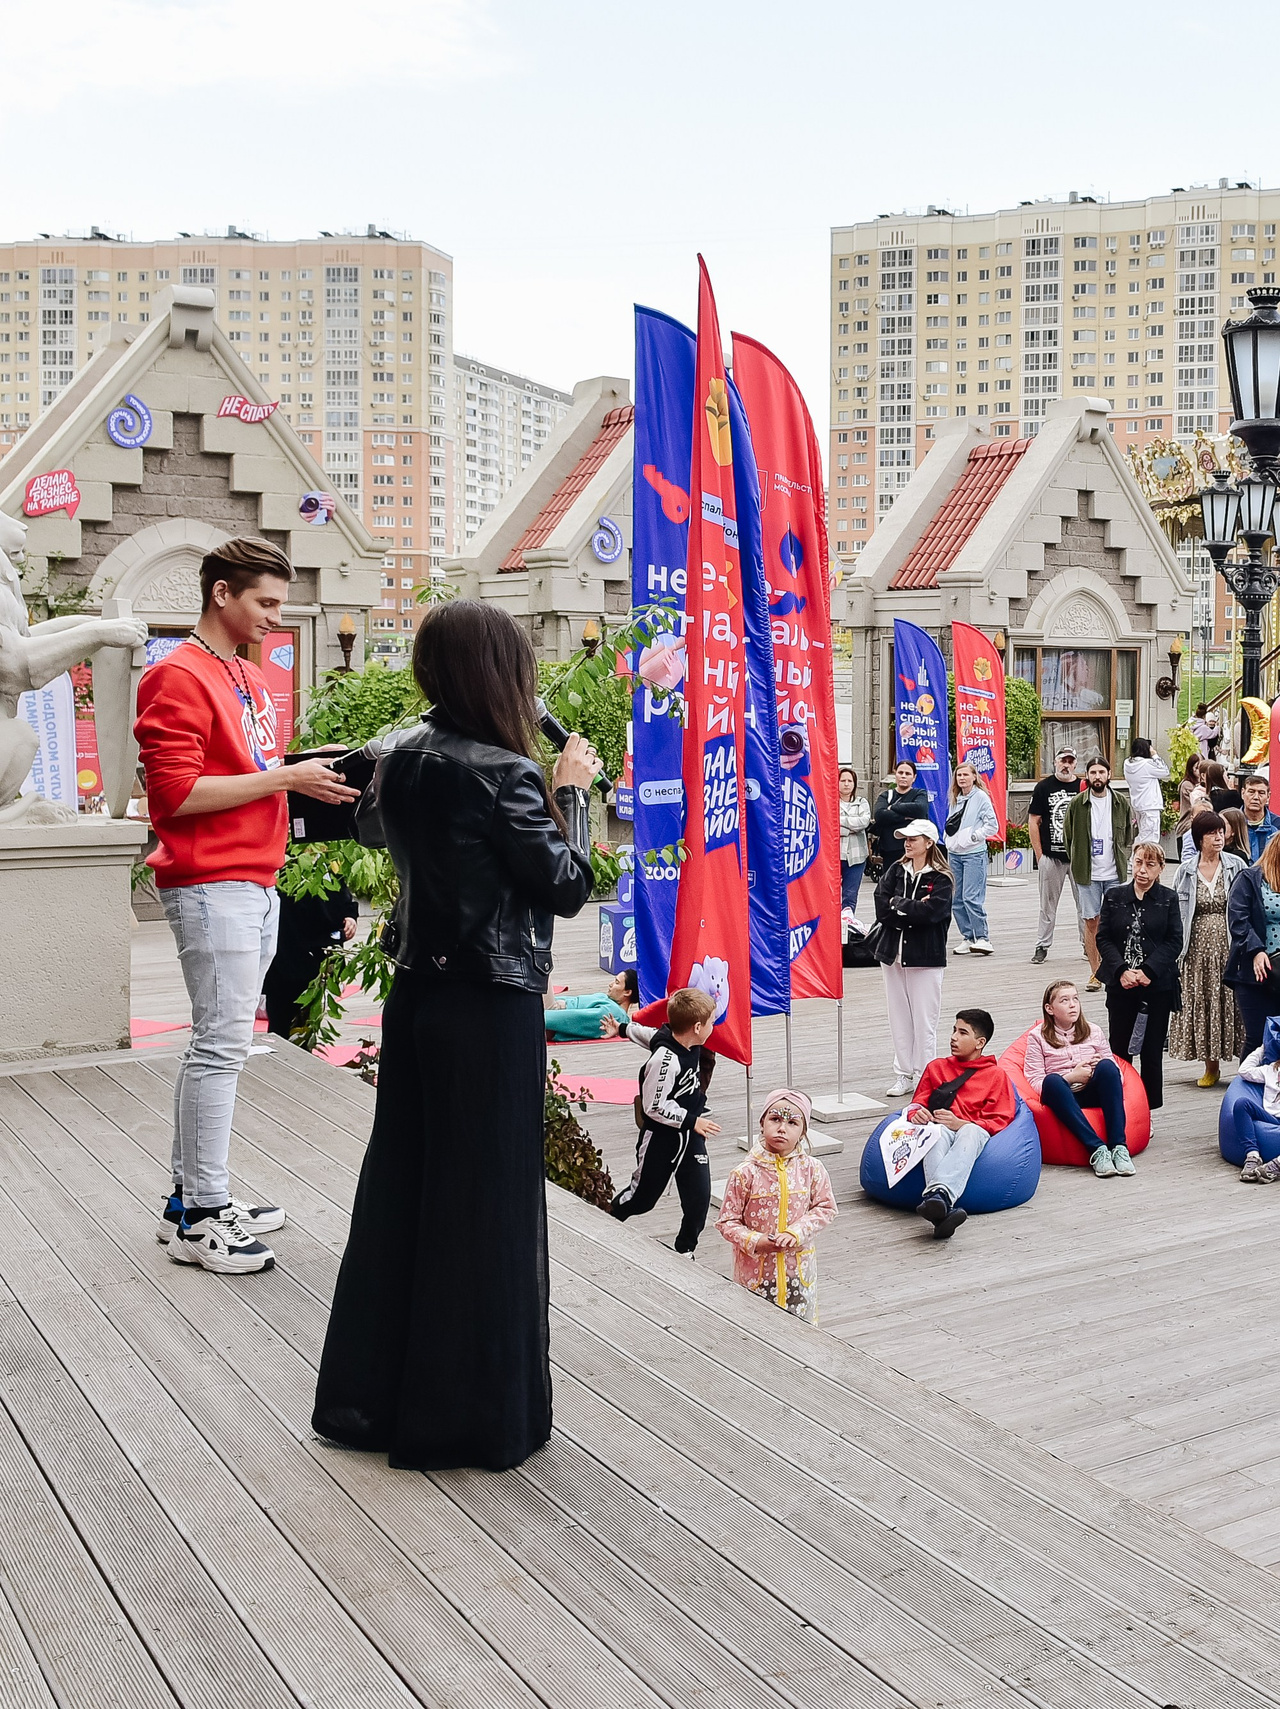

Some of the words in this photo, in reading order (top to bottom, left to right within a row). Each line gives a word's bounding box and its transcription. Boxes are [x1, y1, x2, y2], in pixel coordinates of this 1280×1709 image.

[219, 396, 244, 416] НЕ
[240, 403, 274, 421] СПАТЬ
[29, 472, 68, 497] ДЕЛАЮ
[33, 482, 72, 502] БИЗНЕС
[27, 500, 38, 511] НА
[40, 490, 78, 510] РАЙОНЕ
[900, 713, 939, 725] спаль-
[960, 713, 997, 723] спаль-
[913, 726, 937, 738] ный
[972, 726, 994, 736] ный
[901, 736, 938, 749] район
[962, 736, 995, 747] район
